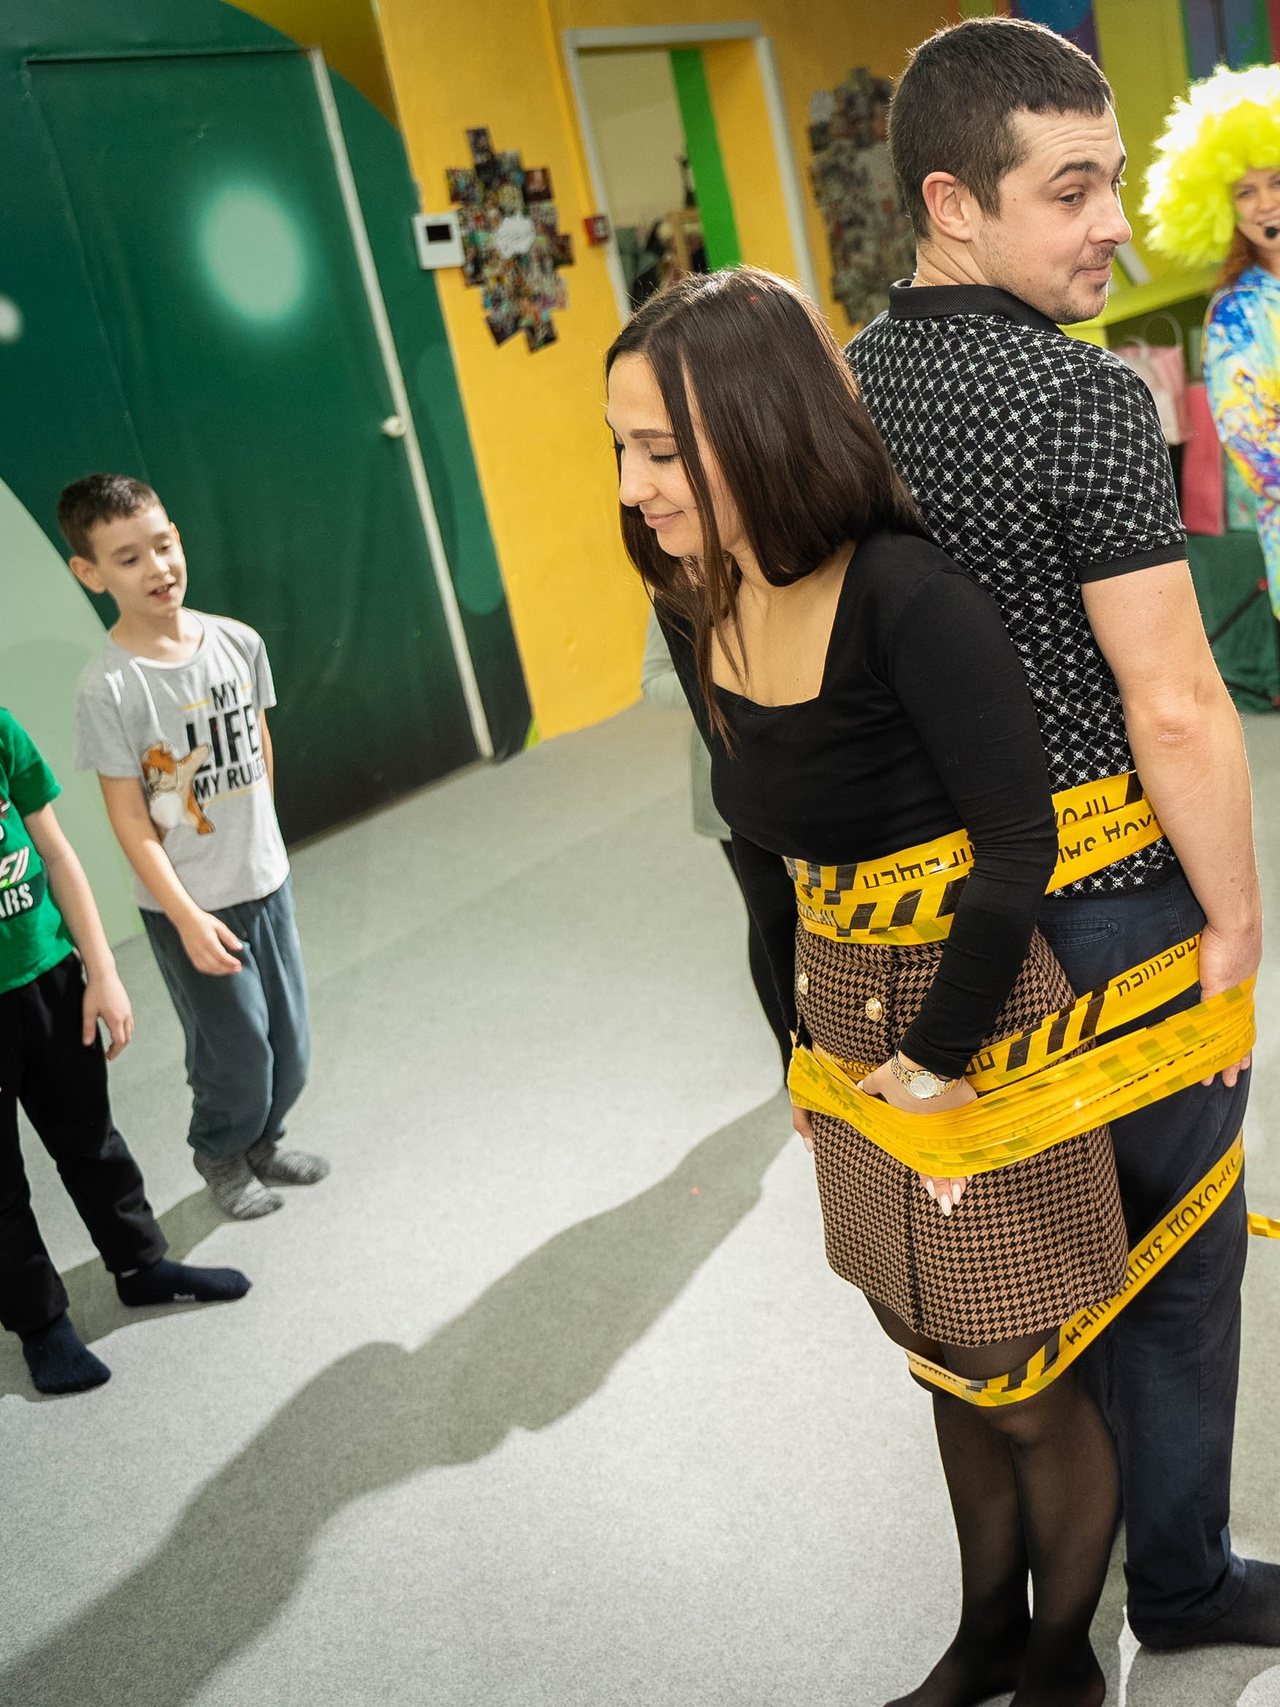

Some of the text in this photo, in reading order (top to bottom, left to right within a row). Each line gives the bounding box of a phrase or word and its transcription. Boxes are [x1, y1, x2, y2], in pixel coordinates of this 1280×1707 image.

[211, 680, 237, 710] MY
[186, 704, 258, 774] LIFE
[194, 773, 219, 799] MY
